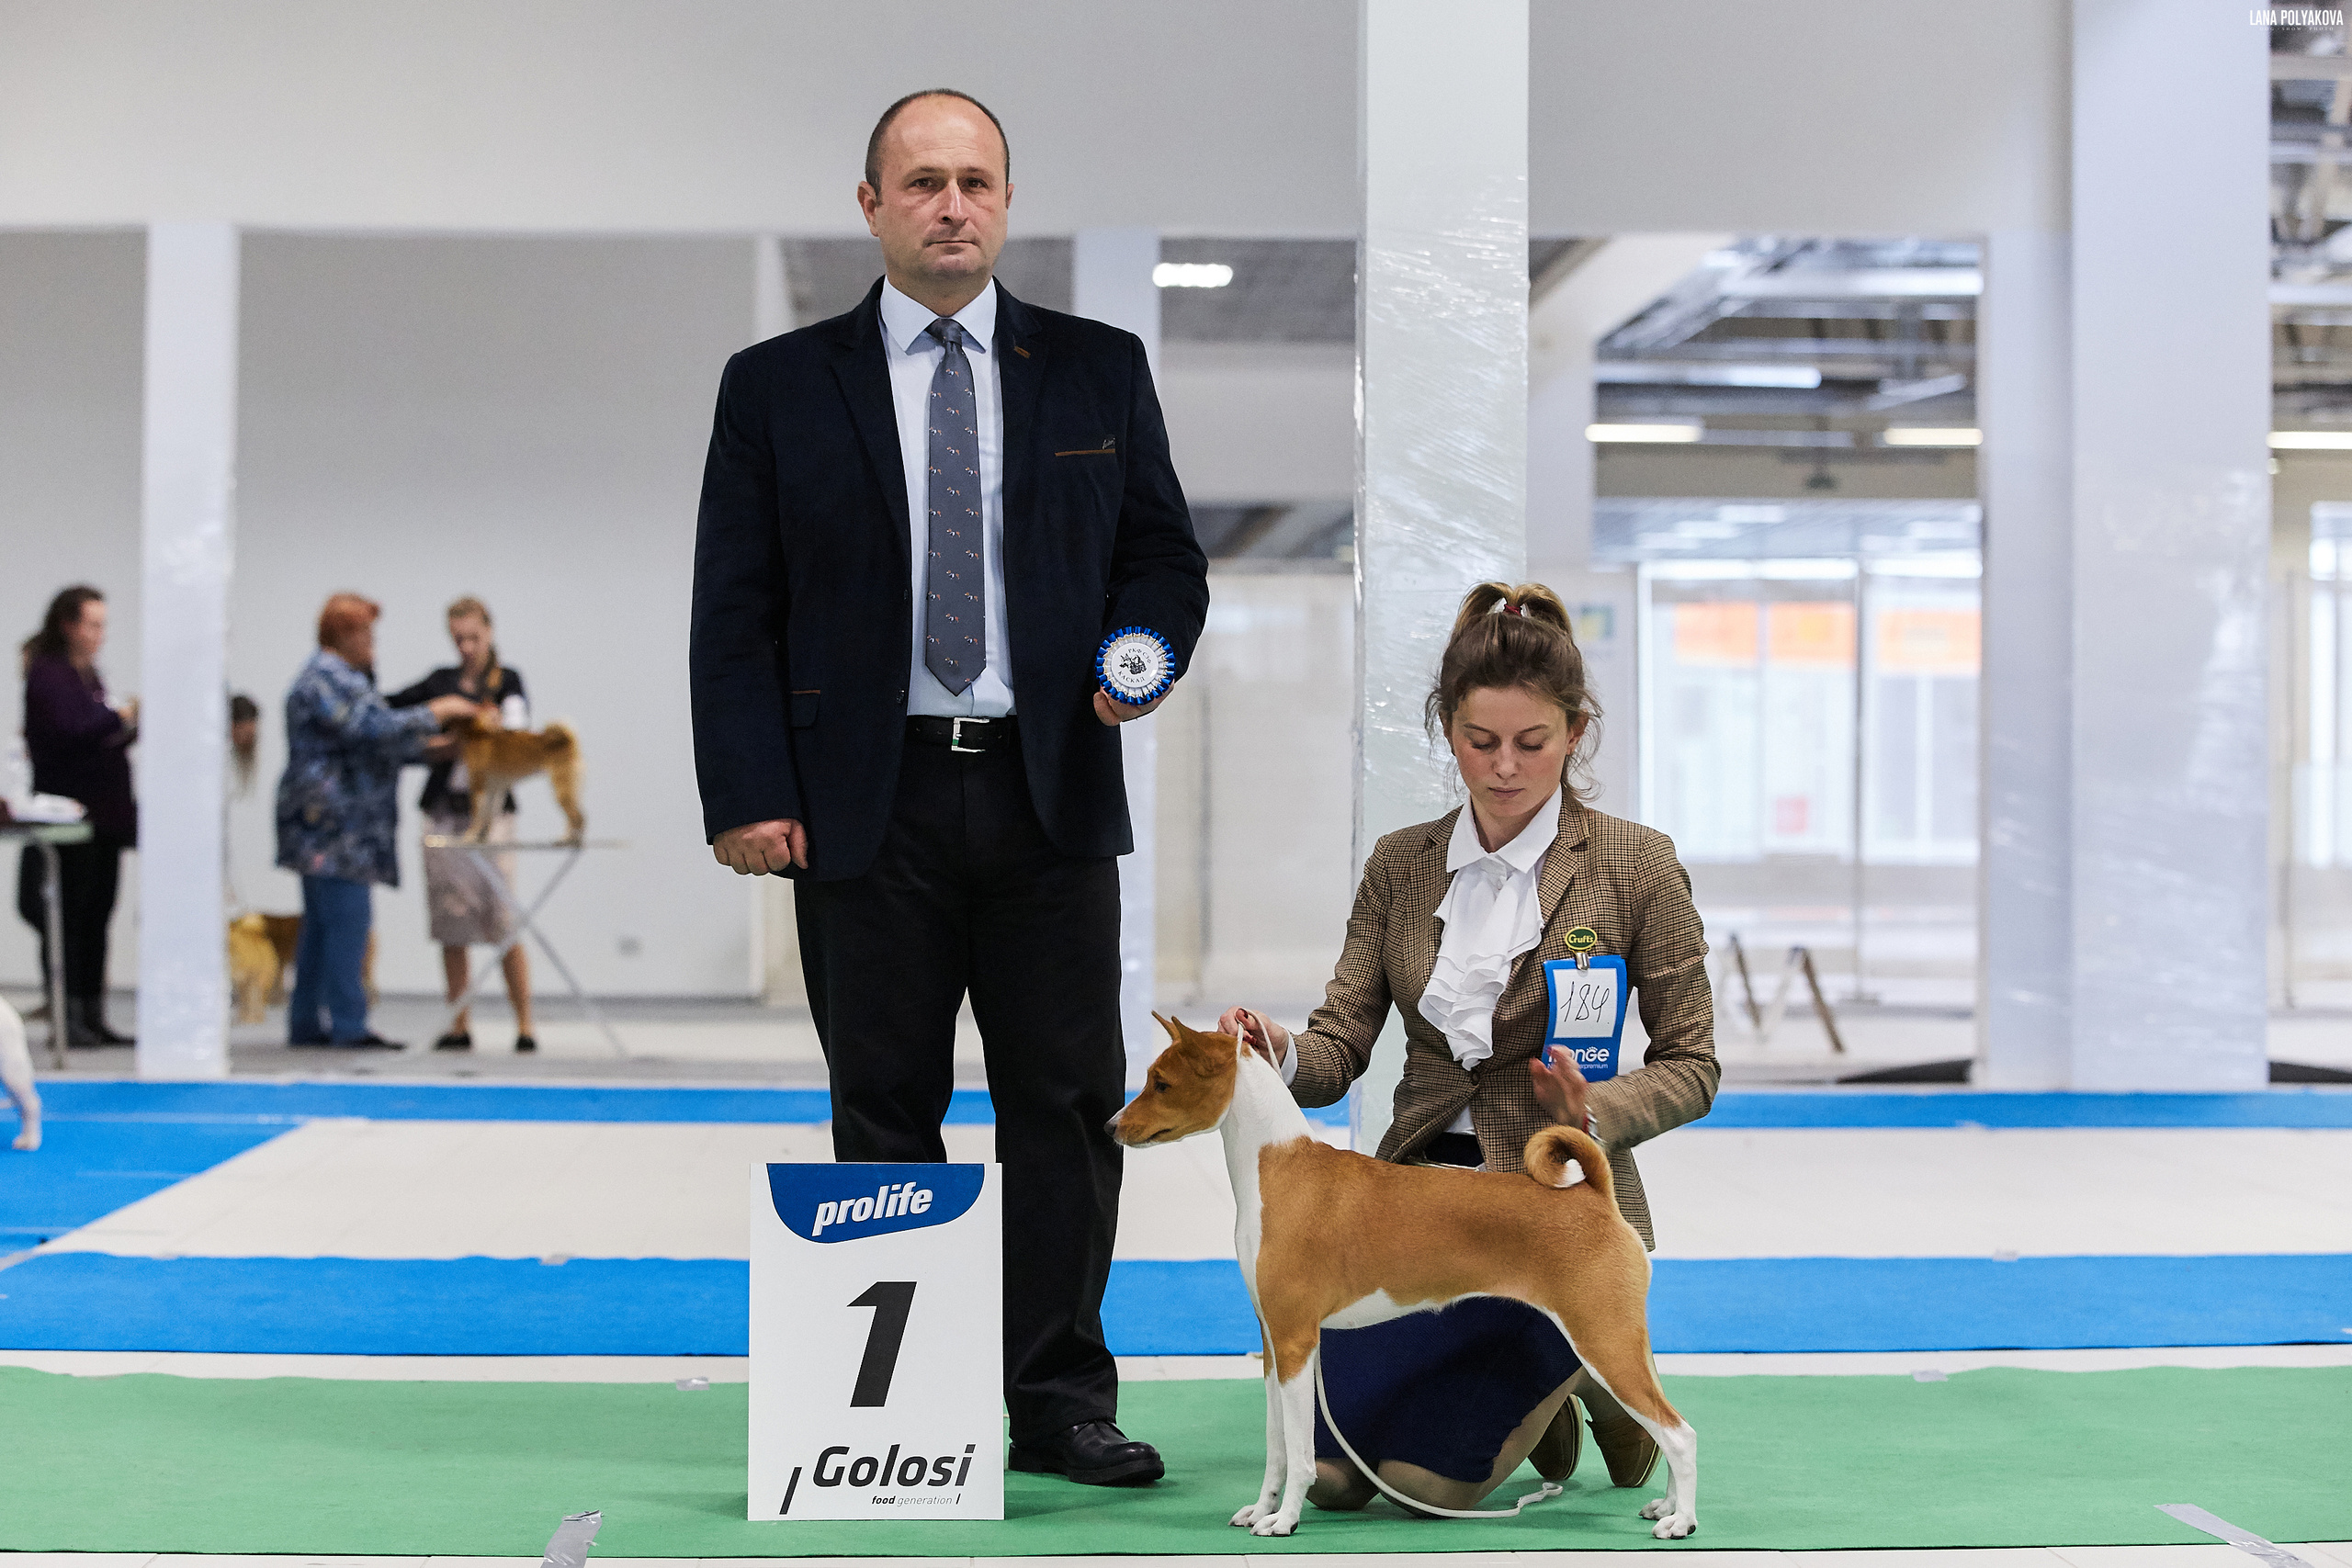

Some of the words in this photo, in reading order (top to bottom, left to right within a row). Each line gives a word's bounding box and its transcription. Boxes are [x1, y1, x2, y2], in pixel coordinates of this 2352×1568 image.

[1118, 671, 1146, 683] КАСКАД
[1568, 933, 1594, 943] Crufts
[811, 1181, 933, 1236] prolife
[846, 1280, 917, 1407] 1
[812, 1444, 976, 1487] Golosi
[872, 1495, 896, 1505] food
[897, 1495, 953, 1507] generation
